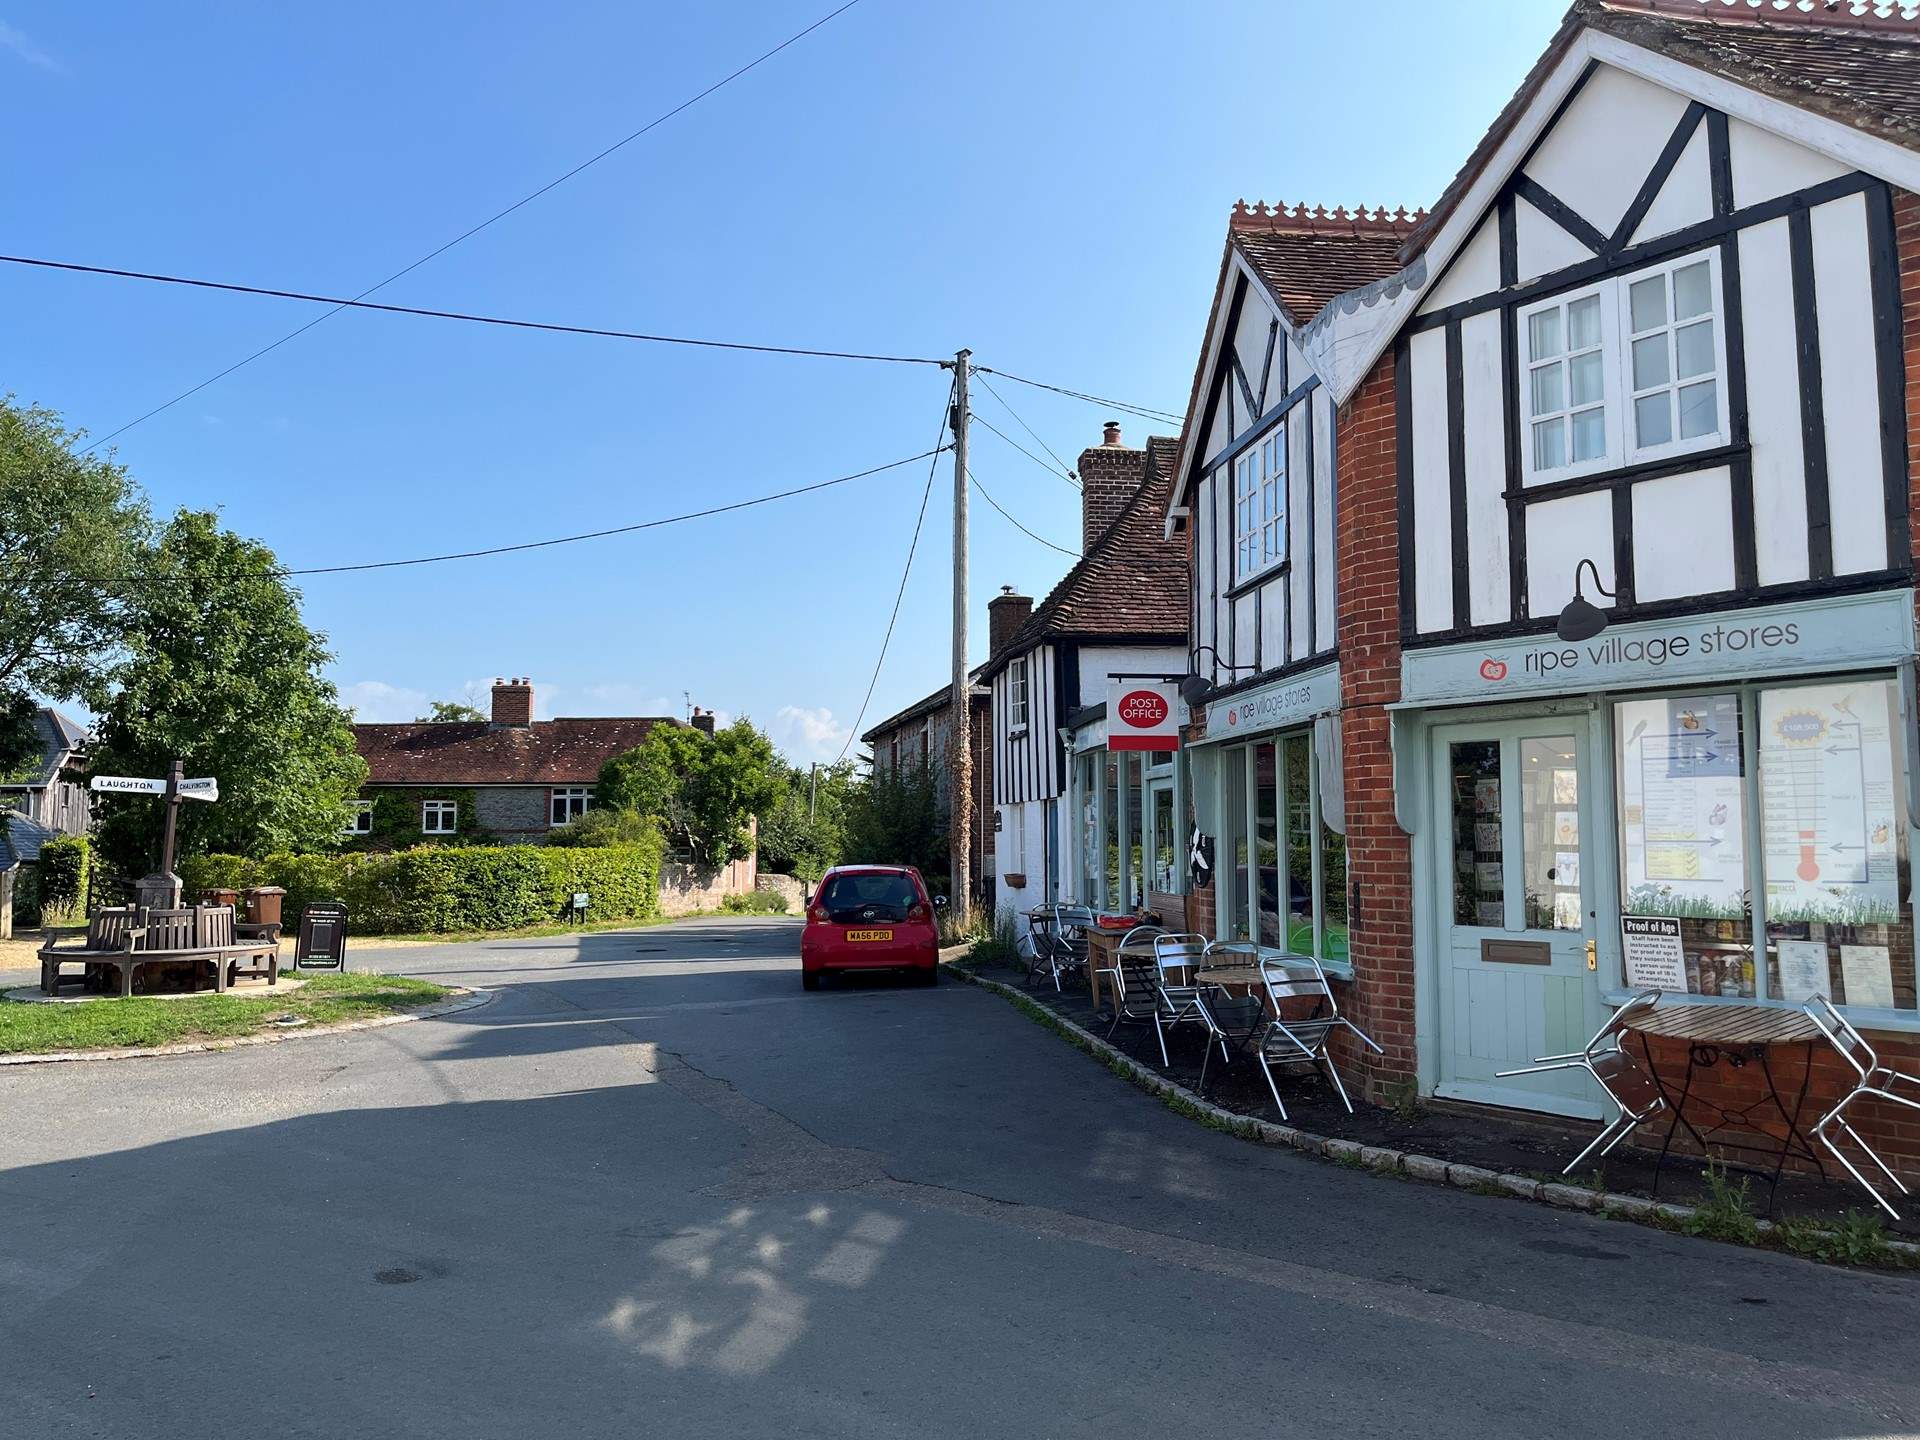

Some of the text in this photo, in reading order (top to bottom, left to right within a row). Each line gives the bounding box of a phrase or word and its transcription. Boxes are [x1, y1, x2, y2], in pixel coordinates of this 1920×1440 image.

[1525, 623, 1799, 676] ripe village stores
[1130, 698, 1158, 708] POST
[1255, 694, 1283, 716] village
[1285, 686, 1311, 708] stores
[1123, 708, 1162, 719] OFFICE
[100, 780, 153, 790] LAUGHTON
[179, 781, 211, 790] CHALVINGTON
[1626, 920, 1676, 935] Proof of Age
